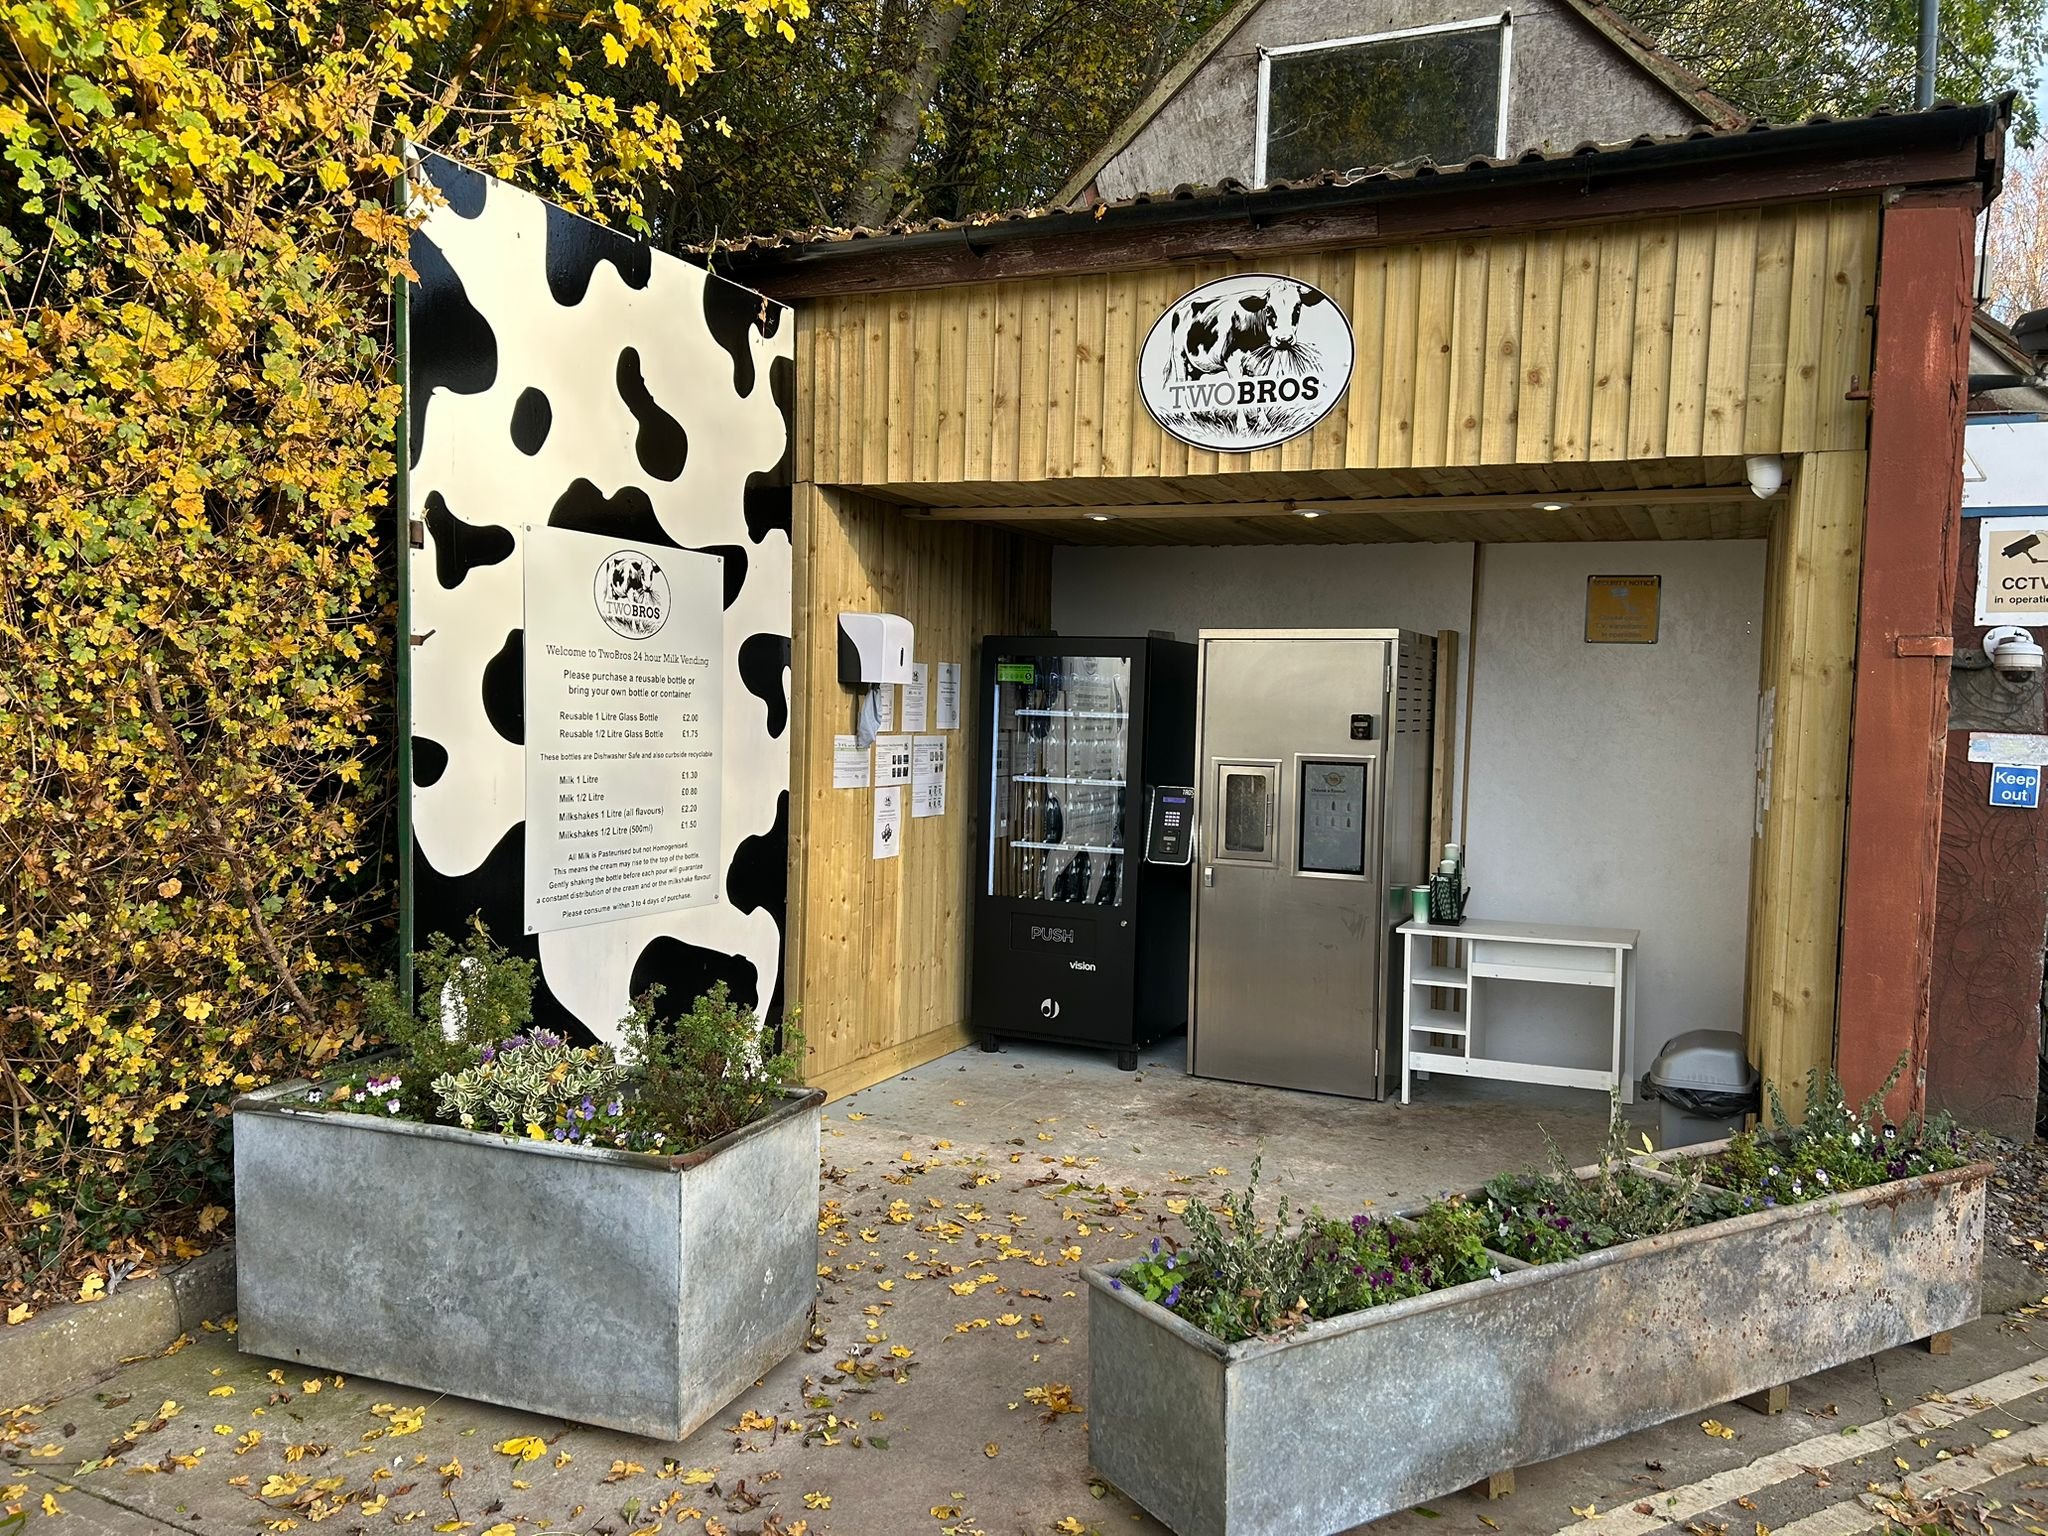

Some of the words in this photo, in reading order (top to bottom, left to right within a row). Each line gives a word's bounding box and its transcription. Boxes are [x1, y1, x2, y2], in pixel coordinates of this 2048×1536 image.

[1169, 376, 1319, 408] TWOBROS
[1994, 595, 2004, 604] in
[606, 600, 660, 619] TWOBROS
[546, 644, 586, 658] Welcome
[588, 649, 596, 658] to
[598, 648, 632, 660] TwoBros
[634, 651, 642, 661] 24
[644, 652, 661, 663] hour
[663, 653, 679, 664] Milk
[680, 655, 709, 668] Vending
[564, 669, 590, 680] Please
[592, 672, 627, 682] purchase
[636, 675, 665, 684] reusable
[667, 675, 686, 684] bottle
[568, 685, 589, 698] bring
[591, 688, 609, 698] your
[628, 688, 648, 697] bottle
[660, 690, 691, 698] container
[560, 711, 593, 720] Reusable
[596, 712, 599, 720] 1
[601, 712, 617, 720] Litre
[619, 712, 638, 721] Glass
[639, 712, 658, 721] Bottle
[682, 714, 699, 722] £2.00
[560, 729, 593, 738] Reusable
[607, 729, 622, 738] Litre
[624, 729, 642, 738] Glass
[644, 729, 663, 738] Bottle
[682, 729, 698, 738] £1.75
[688, 751, 712, 759] recyclable
[560, 776, 574, 784] Milk
[577, 776, 580, 784] 1
[582, 775, 599, 784] Litre
[682, 771, 698, 780] £1.30
[1996, 772, 2036, 788] Keep
[560, 794, 574, 802] Milk
[588, 793, 604, 801] Litre
[2002, 789, 2028, 800] out
[559, 811, 598, 821] Milkshakes
[601, 810, 604, 818] 1
[606, 809, 622, 818] Litre
[624, 808, 633, 818] (all
[636, 806, 664, 816] flavours)
[681, 804, 697, 813] £2.20
[559, 829, 598, 840] Milkshakes
[612, 826, 627, 835] Litre
[629, 824, 653, 835] (500ml)
[681, 820, 697, 829] £1.50
[598, 848, 631, 858] Pasteurised
[600, 862, 617, 870] cream
[549, 881, 569, 889] Gently
[570, 878, 594, 886] shaking
[606, 874, 622, 882] bottle
[623, 871, 640, 880] before
[642, 869, 654, 877] each
[656, 868, 668, 876] pour
[679, 864, 703, 874] guarantee
[542, 894, 569, 903] constant
[570, 889, 604, 899] distribution
[668, 876, 693, 885] milkshake
[562, 910, 582, 918] Please
[584, 906, 610, 915] consume
[613, 902, 630, 911] within
[1031, 926, 1074, 943] PUSH
[1069, 960, 1096, 972] vision
